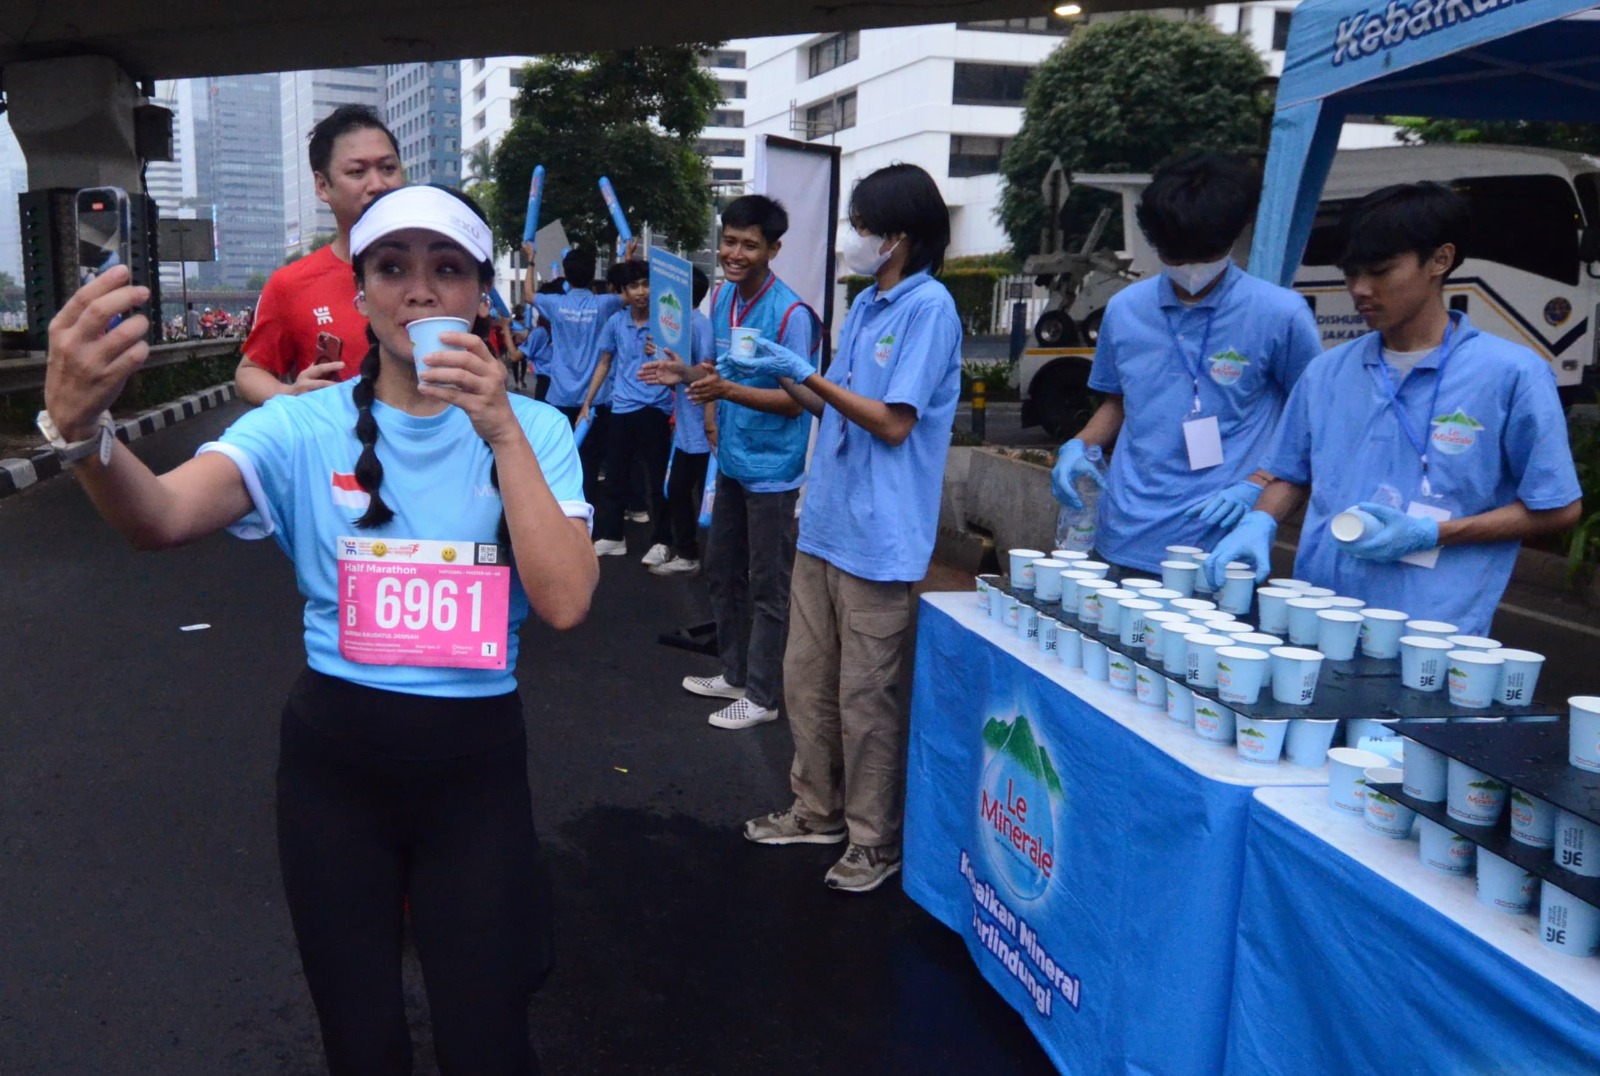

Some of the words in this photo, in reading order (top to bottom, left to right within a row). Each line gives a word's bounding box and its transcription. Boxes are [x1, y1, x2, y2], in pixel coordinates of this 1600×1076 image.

[345, 563, 363, 573] Half
[366, 565, 417, 575] Marathon
[347, 576, 357, 597] F
[347, 605, 357, 627] B
[375, 577, 483, 632] 6961
[487, 644, 492, 654] 1
[1007, 778, 1027, 823] Le
[981, 789, 1053, 878] Minerale
[972, 903, 1052, 1017] rlindungi
[1019, 920, 1080, 1008] Mineral
